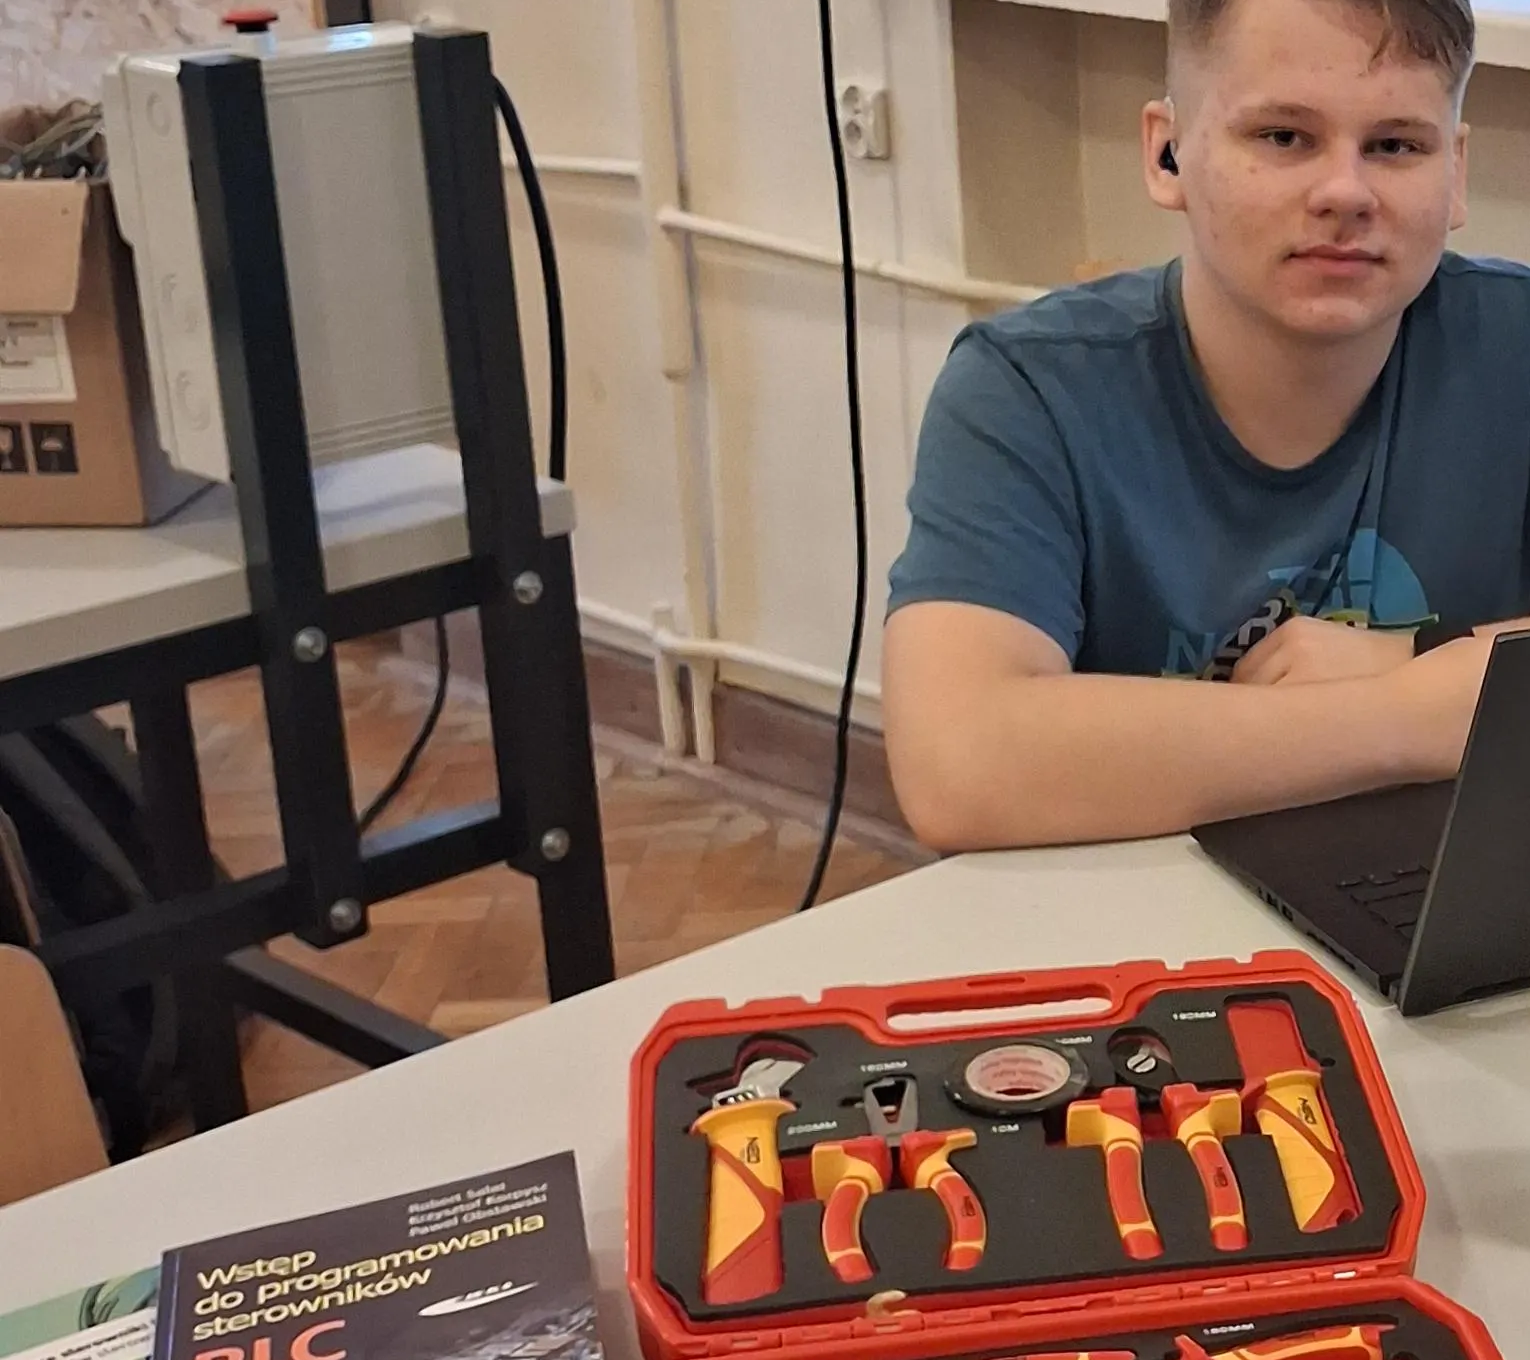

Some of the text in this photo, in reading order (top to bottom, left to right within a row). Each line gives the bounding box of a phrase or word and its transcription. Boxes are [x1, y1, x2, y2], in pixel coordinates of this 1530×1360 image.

[194, 1213, 545, 1316] do programowania
[196, 1249, 317, 1291] Wstęp
[193, 1268, 432, 1341] sterowników
